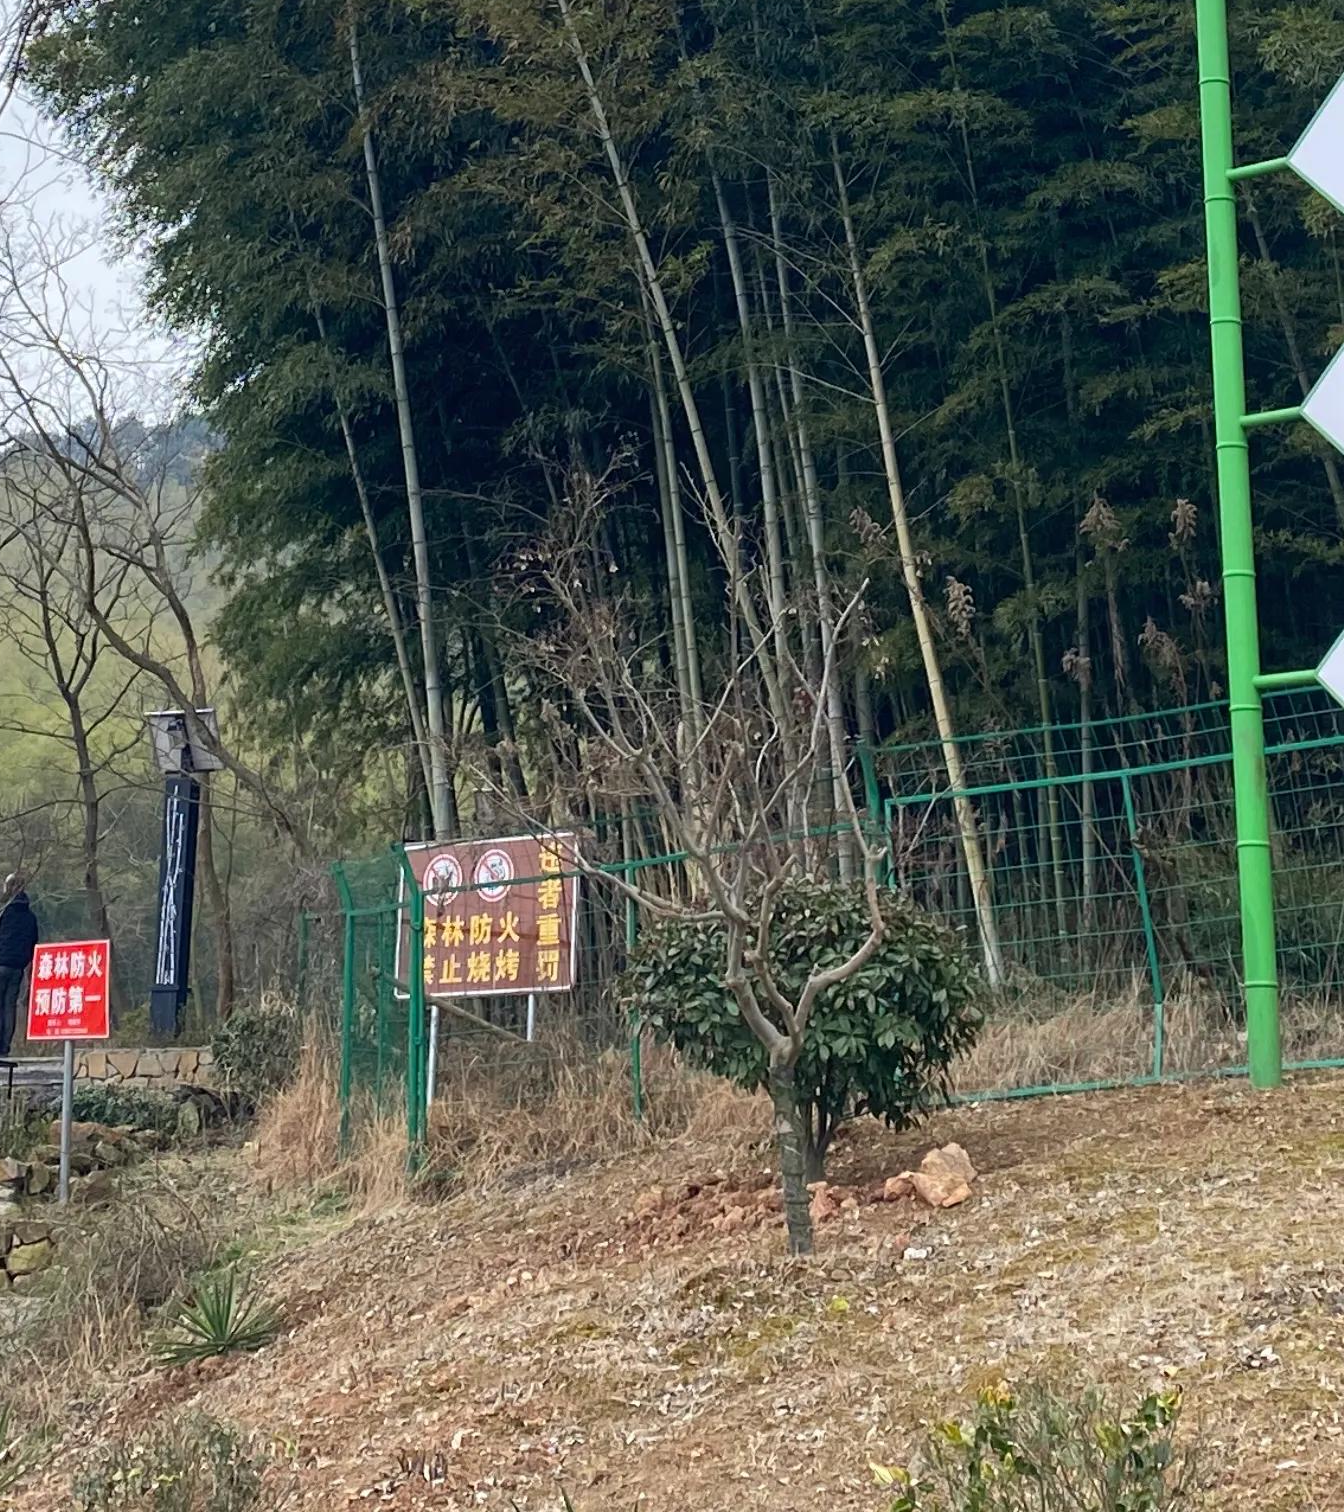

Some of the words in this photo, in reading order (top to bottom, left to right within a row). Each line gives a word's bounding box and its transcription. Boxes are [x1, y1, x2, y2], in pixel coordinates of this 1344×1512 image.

[38, 951, 103, 980] 森林防火
[35, 986, 101, 1016] 预防第一
